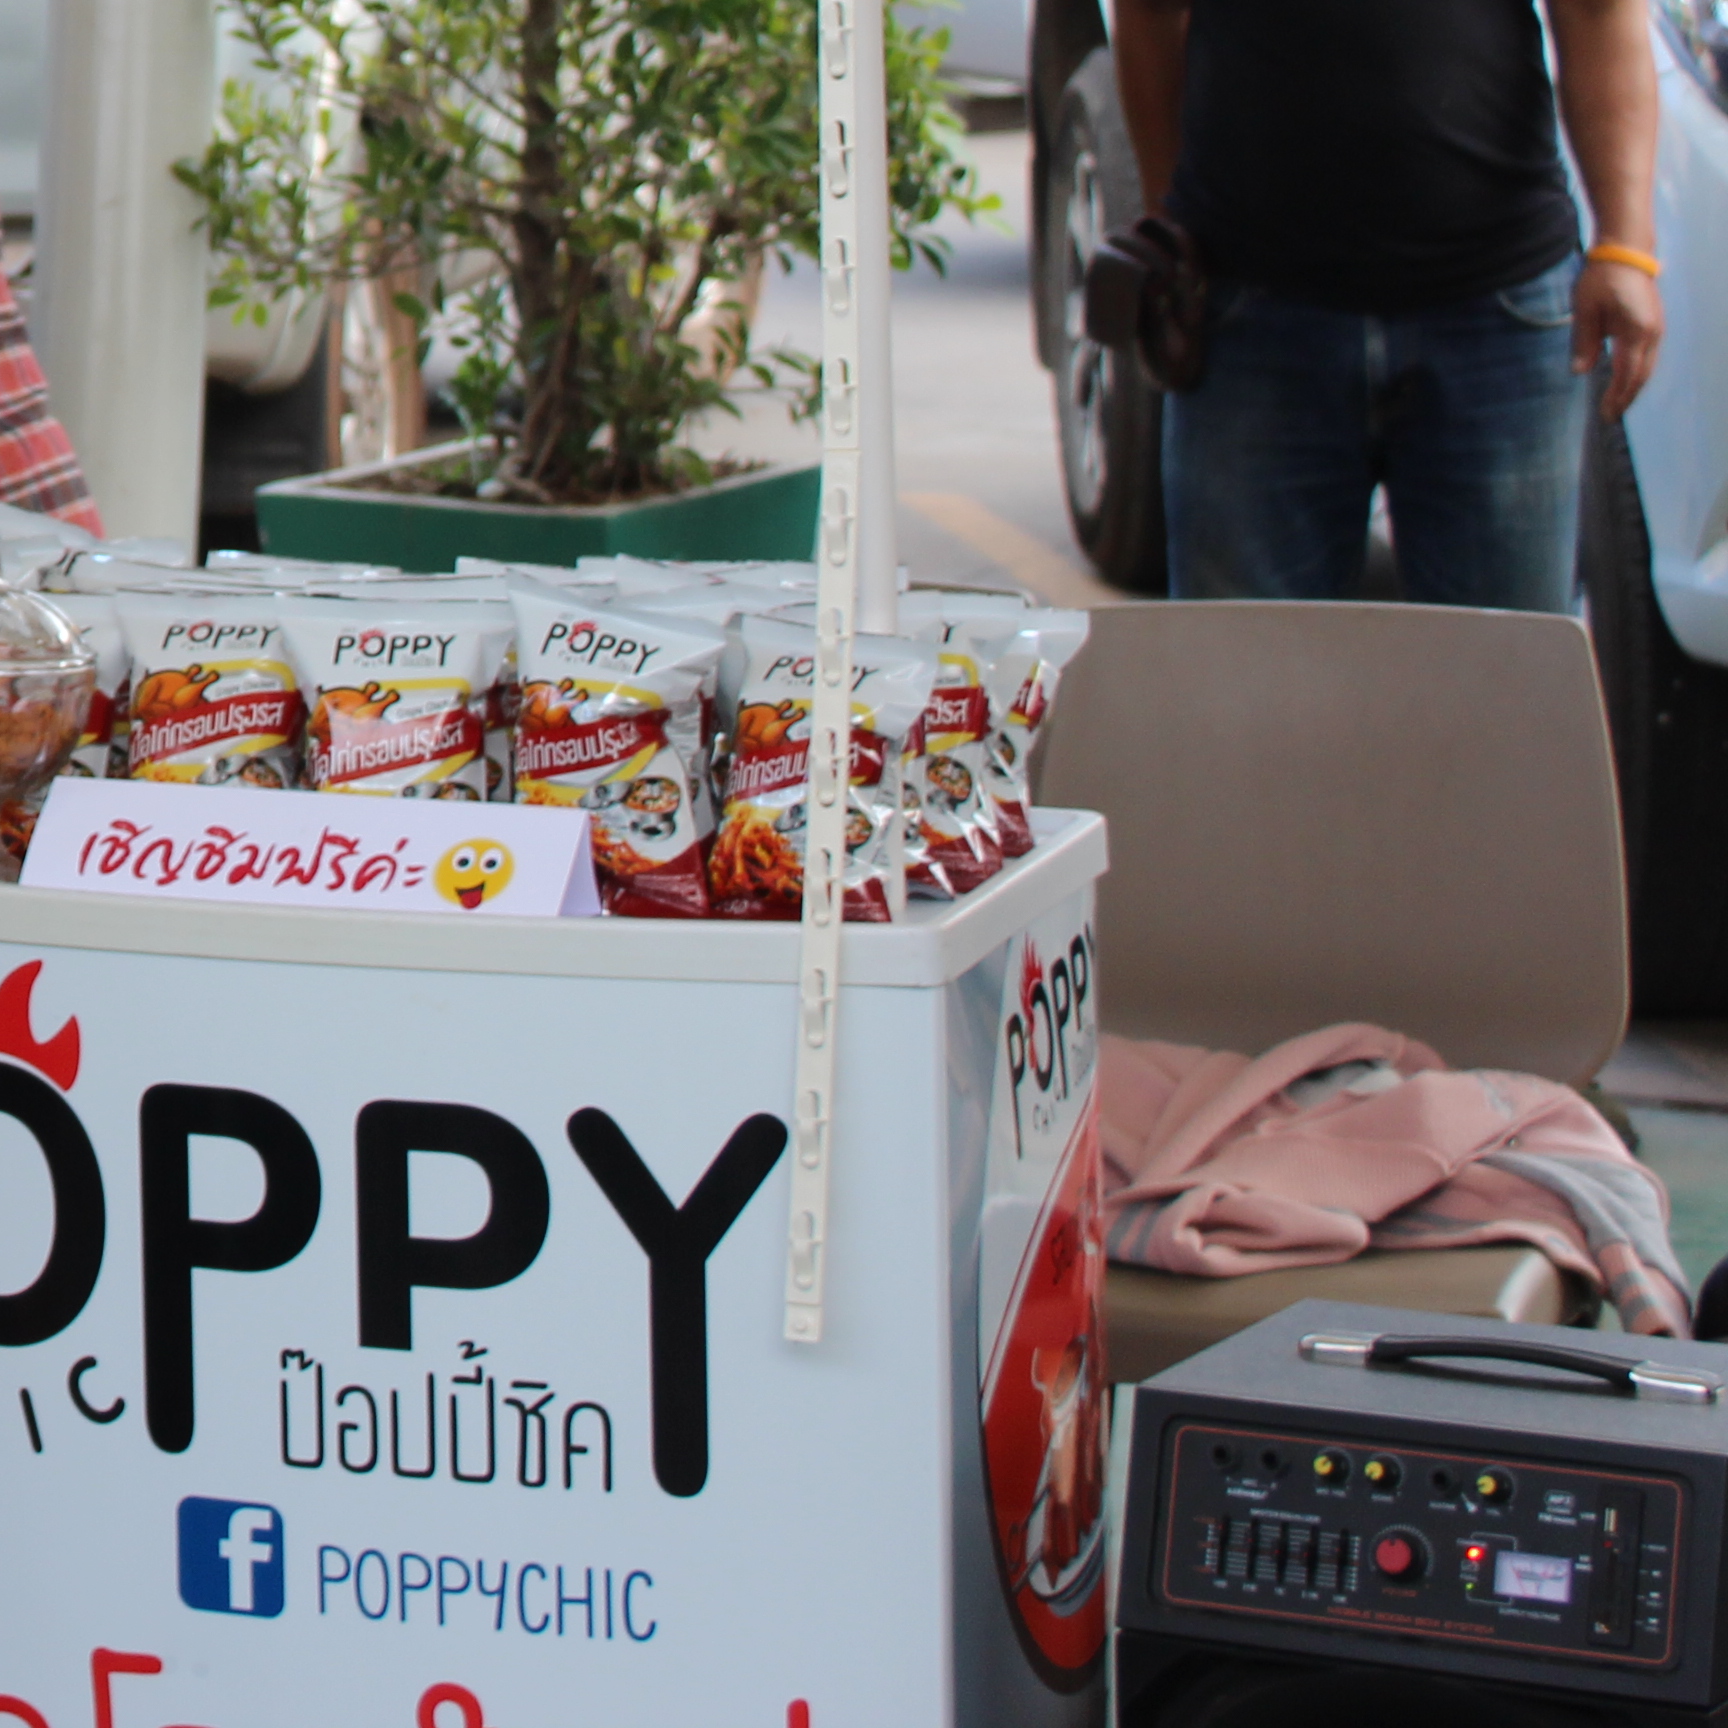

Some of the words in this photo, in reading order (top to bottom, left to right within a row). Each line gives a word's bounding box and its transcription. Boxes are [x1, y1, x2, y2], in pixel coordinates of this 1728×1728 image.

[161, 620, 281, 650] POPPY
[333, 632, 457, 667] POPPY
[540, 621, 661, 675] POPPY
[76, 818, 429, 894] เชิญชิมฟรีค่ะ
[1005, 933, 1098, 1160] POPP
[278, 1340, 616, 1494] ป๊อปปี้ชิค
[315, 1543, 660, 1644] POPPYCHIC
